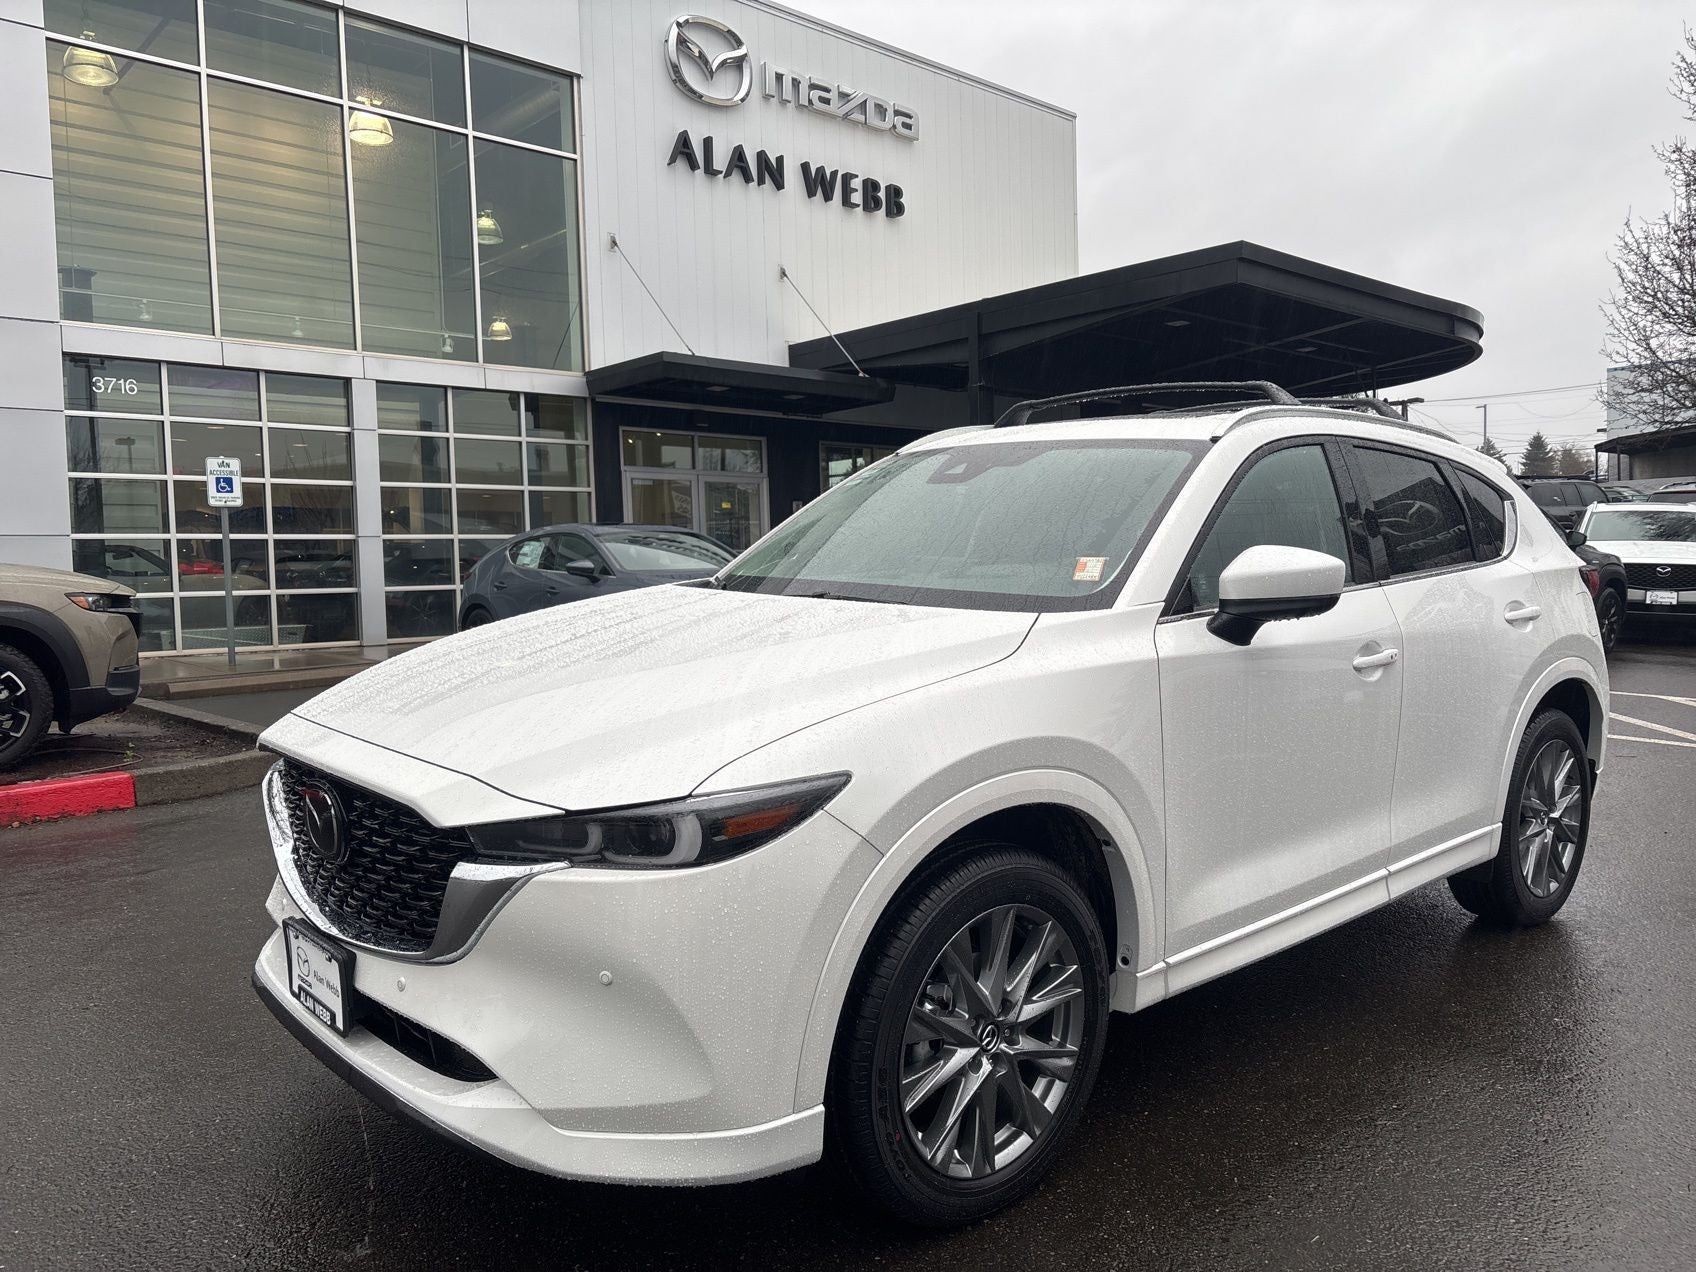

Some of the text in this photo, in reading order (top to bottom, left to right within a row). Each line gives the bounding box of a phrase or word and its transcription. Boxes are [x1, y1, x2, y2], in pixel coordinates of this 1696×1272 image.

[761, 61, 919, 142] mazda
[667, 129, 905, 218] ALAN WEBB
[92, 376, 138, 395] 3716
[209, 469, 239, 477] ACCESSIBLE
[313, 969, 325, 986] Alan
[300, 990, 331, 1025] ALAN WEBB
